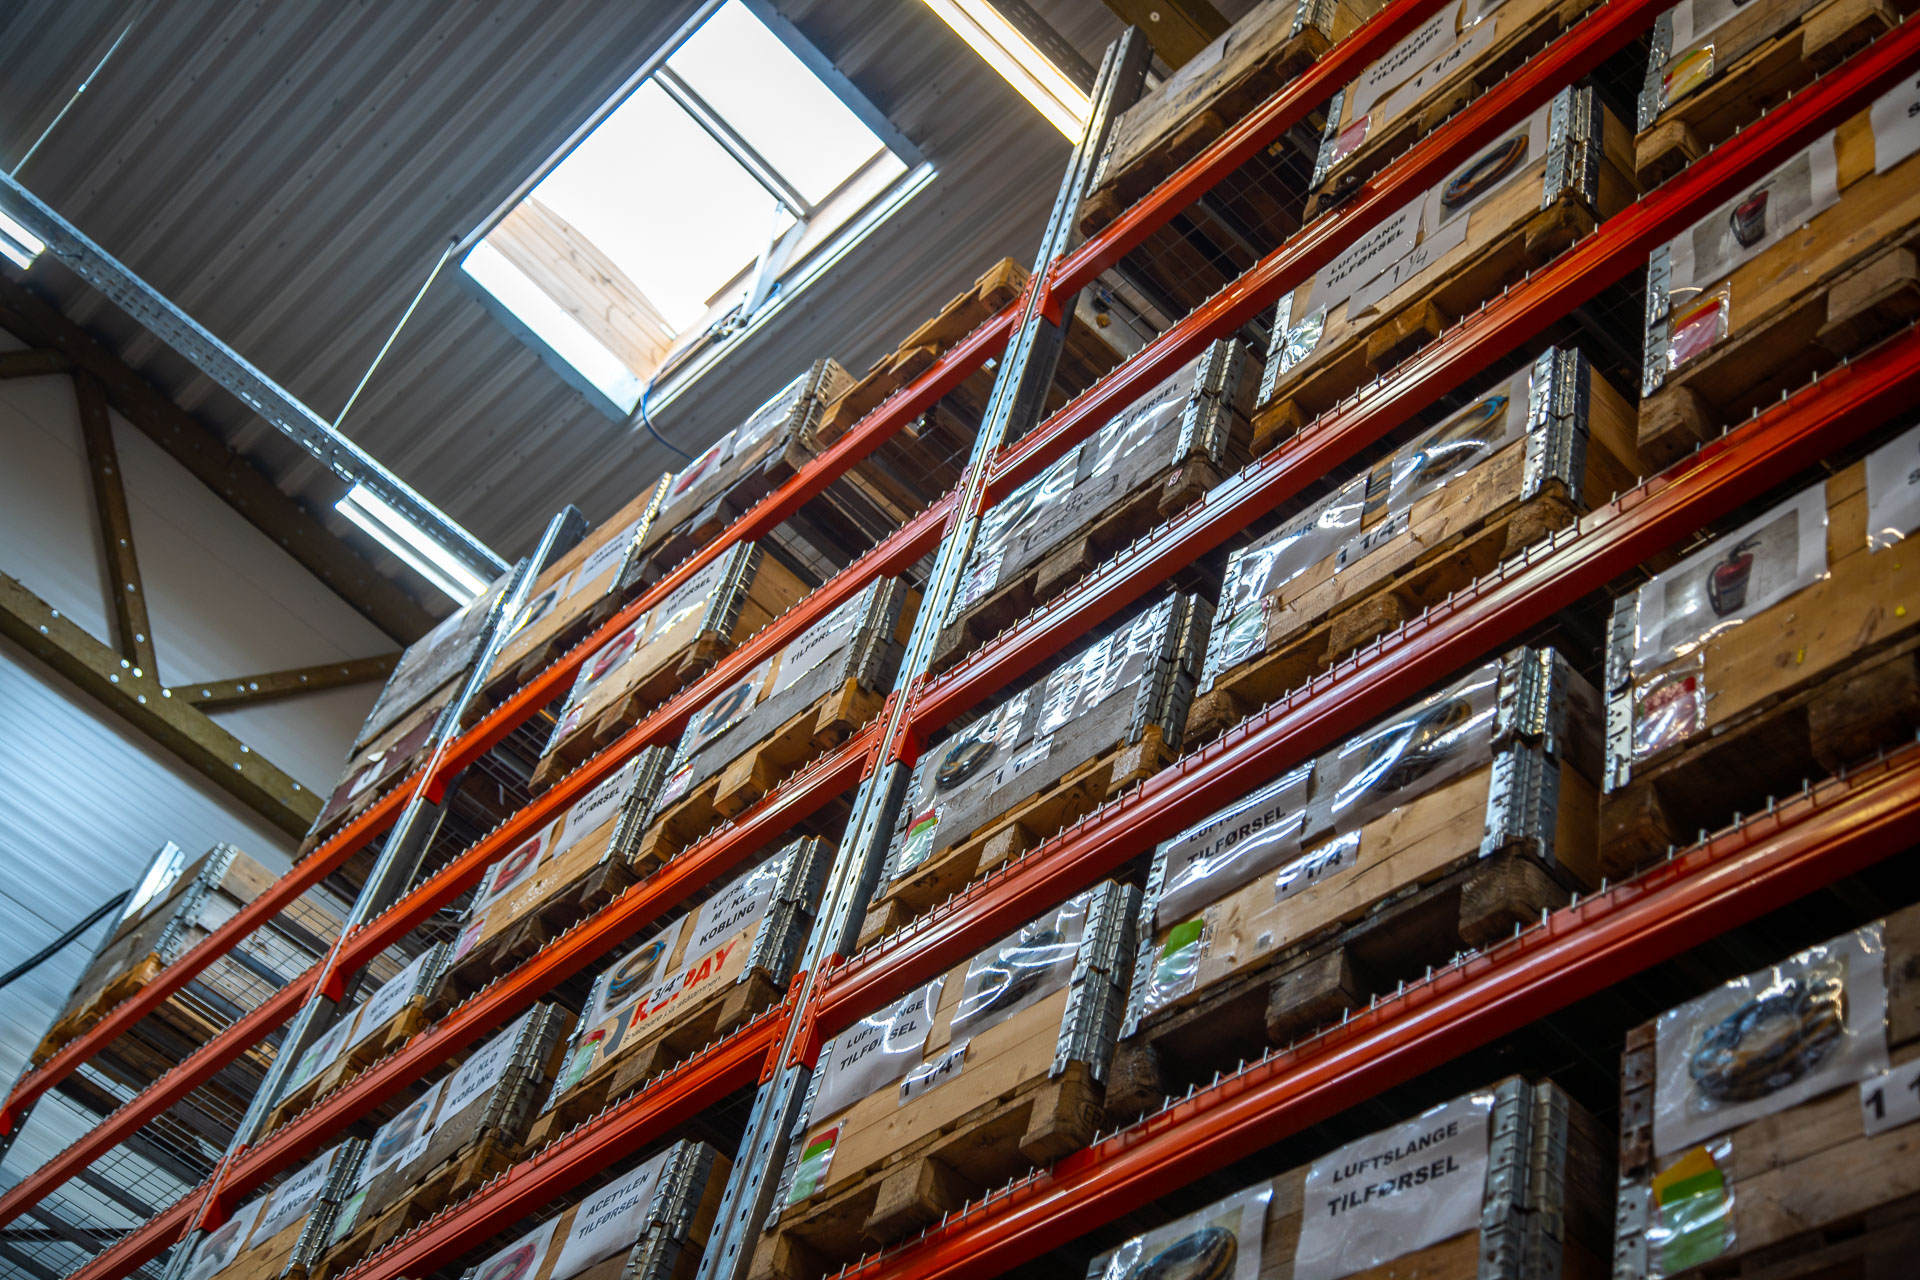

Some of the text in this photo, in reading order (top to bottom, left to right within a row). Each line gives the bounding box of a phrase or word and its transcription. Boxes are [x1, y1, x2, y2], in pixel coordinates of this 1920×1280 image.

[1413, 77, 1422, 88] 1
[1326, 229, 1404, 288] TILFØRSEL
[1331, 214, 1406, 275] LUFTSLANGE
[1392, 265, 1399, 283] 1
[1337, 548, 1348, 564] 1
[573, 787, 620, 826] TILFØRSEL
[1187, 806, 1287, 864] TILFØRSEL
[699, 901, 756, 946] KOBLING
[651, 972, 685, 1003] 3/4"
[449, 1068, 494, 1109] KOBLING
[1333, 1121, 1459, 1184] LUFTSLANGE
[262, 1188, 314, 1228] SLANGE
[586, 1171, 650, 1218] ACETYLEN
[1328, 1154, 1460, 1217] TILFØRSEL
[578, 1194, 640, 1239] TILFØRSEL
